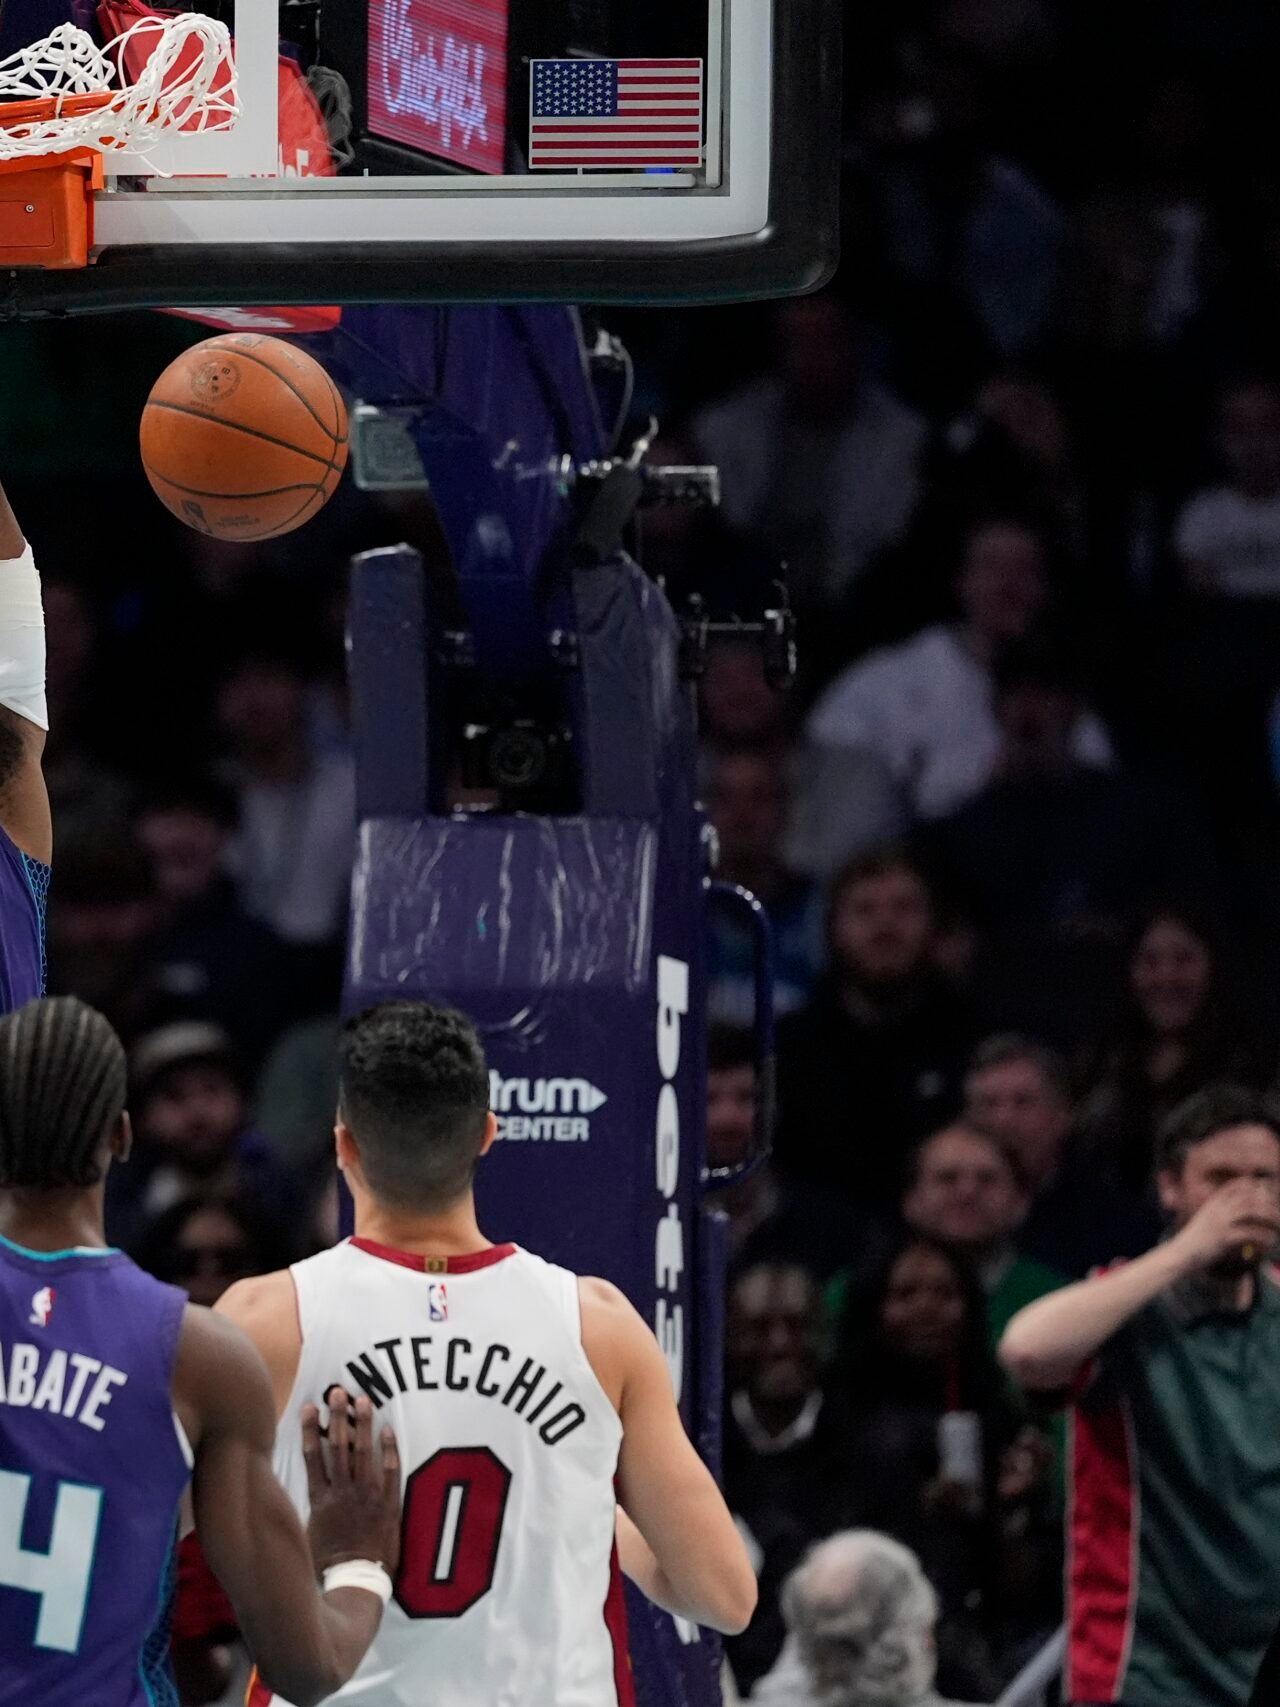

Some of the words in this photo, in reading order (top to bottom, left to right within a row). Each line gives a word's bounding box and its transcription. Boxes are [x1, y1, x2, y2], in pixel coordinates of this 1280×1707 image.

[489, 1069, 591, 1114] trum
[318, 1337, 586, 1446] NTECCHIO
[393, 1445, 513, 1620] 0
